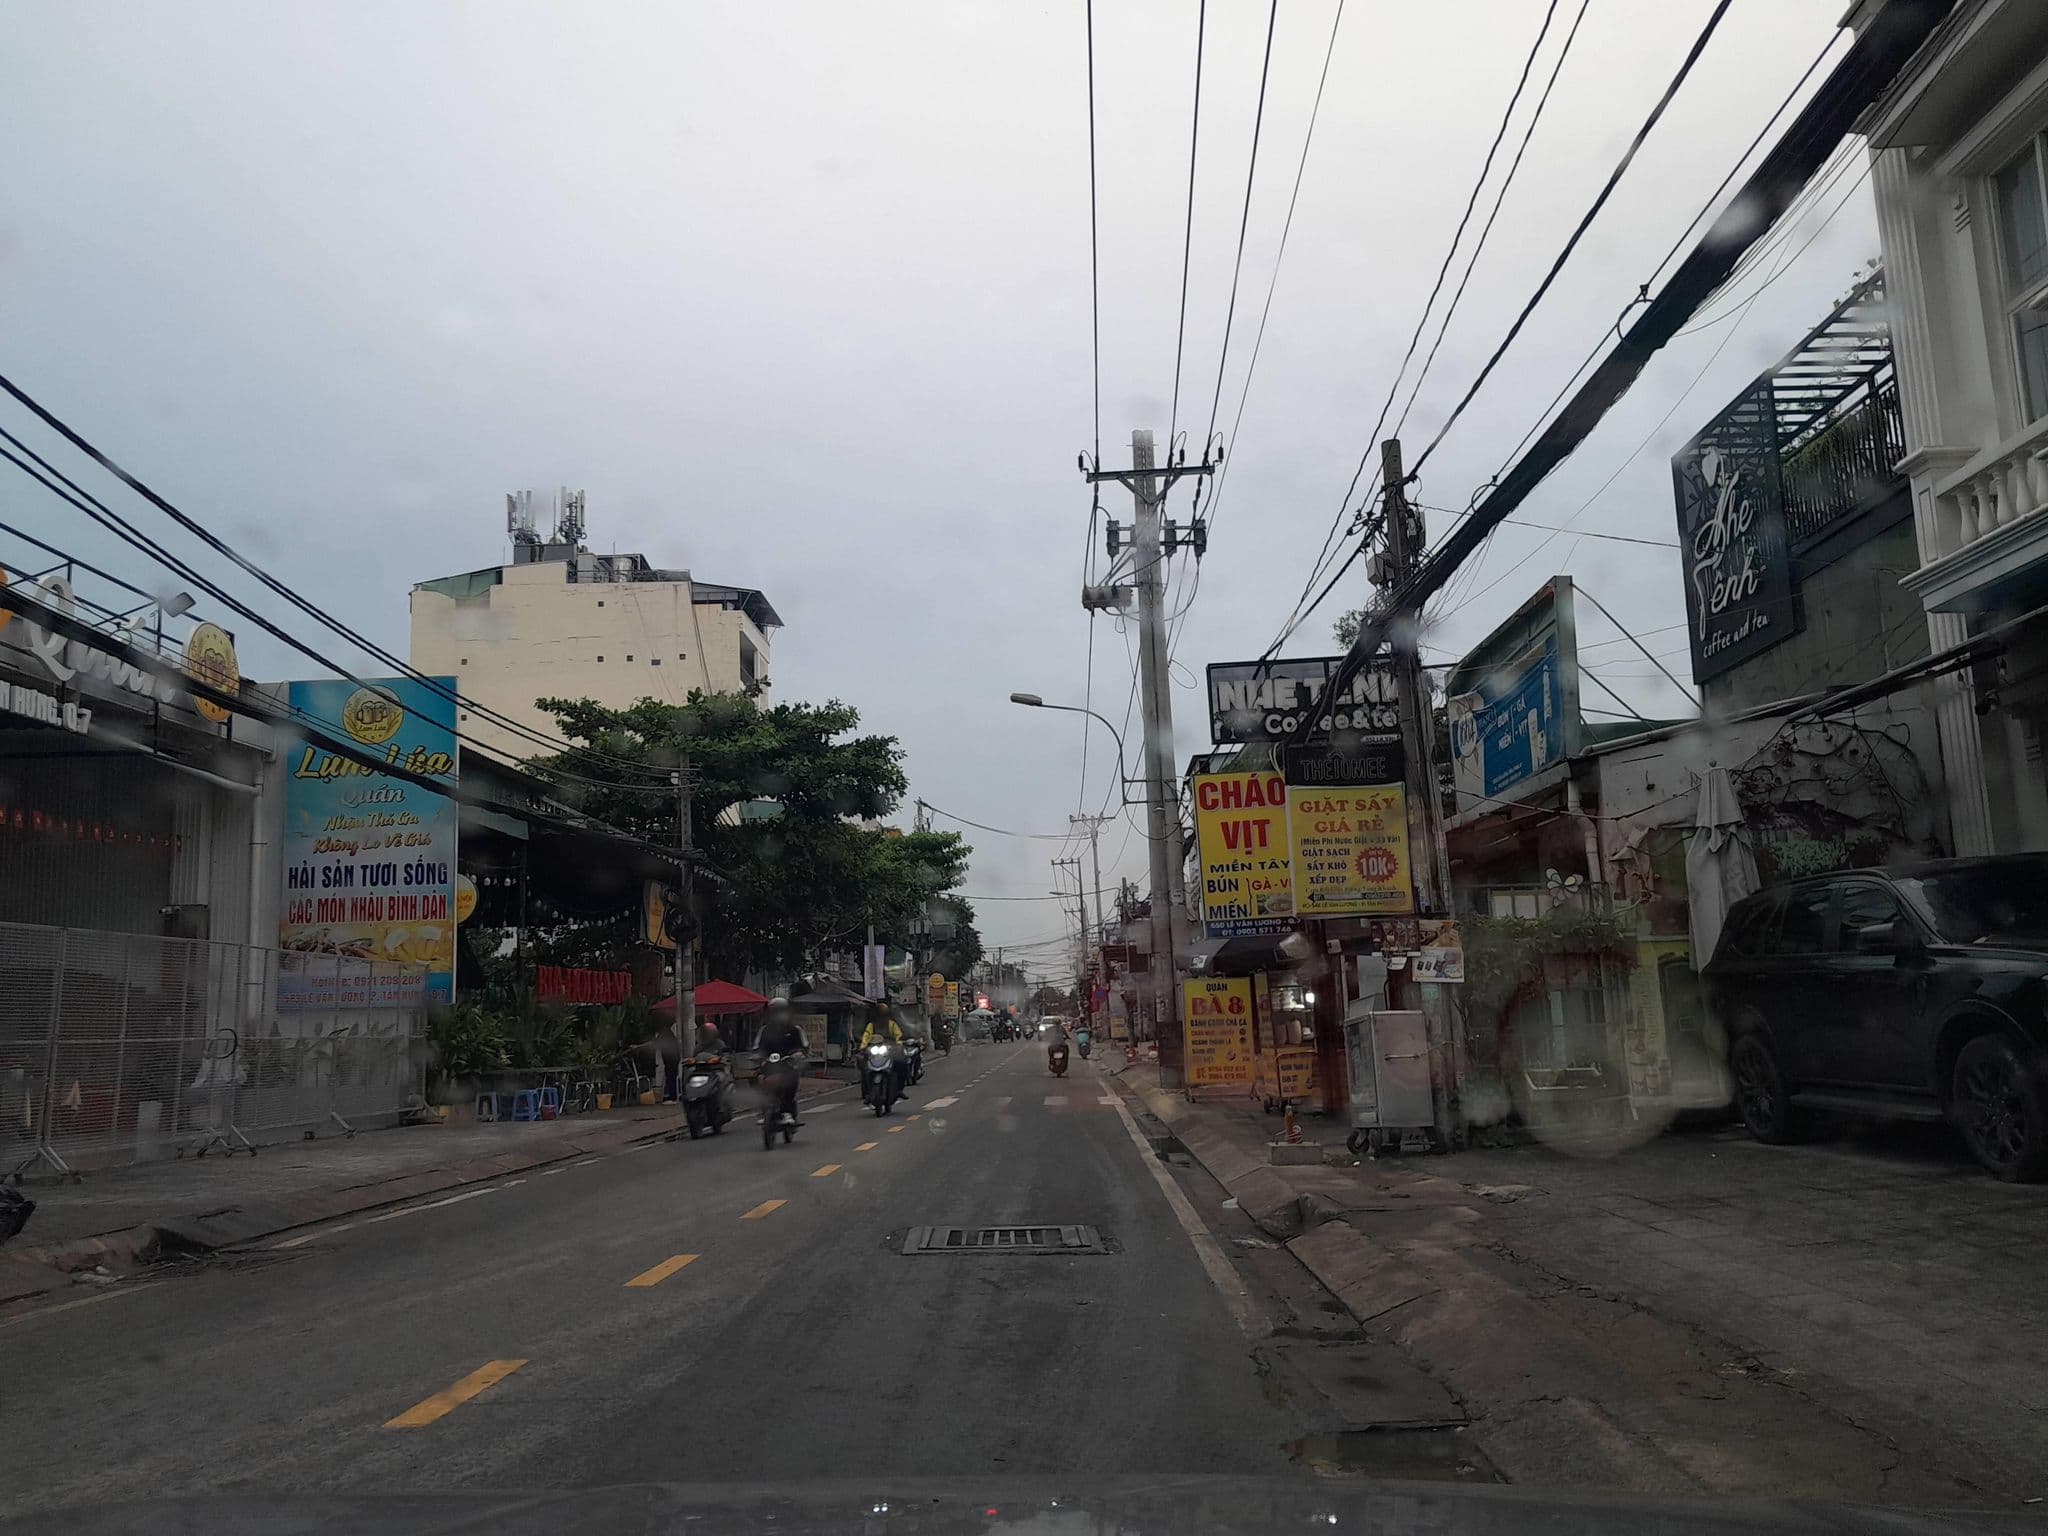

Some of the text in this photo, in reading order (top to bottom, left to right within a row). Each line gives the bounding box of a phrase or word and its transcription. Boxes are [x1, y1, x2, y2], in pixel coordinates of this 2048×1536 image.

[1703, 610, 1768, 658] coffee and tea
[1198, 773, 1286, 811] CHÁO
[1299, 793, 1395, 816] GIẶT SẤY
[1314, 814, 1384, 833] GIÁ RẺ
[1221, 819, 1270, 855] VỊT
[288, 854, 448, 889] HẢI SẢN TƯƠI SỐNG
[1360, 858, 1388, 876] 10K
[1207, 874, 1239, 893] BÚN
[1252, 876, 1271, 891] GÀ
[1309, 873, 1327, 884] XẾP
[289, 890, 447, 928] CÁC MÓN NHẬU BÌNH DÂN
[1209, 898, 1248, 919] MIẾN
[1206, 981, 1228, 992] QUÁN
[1192, 993, 1245, 1015] BÀ 8
